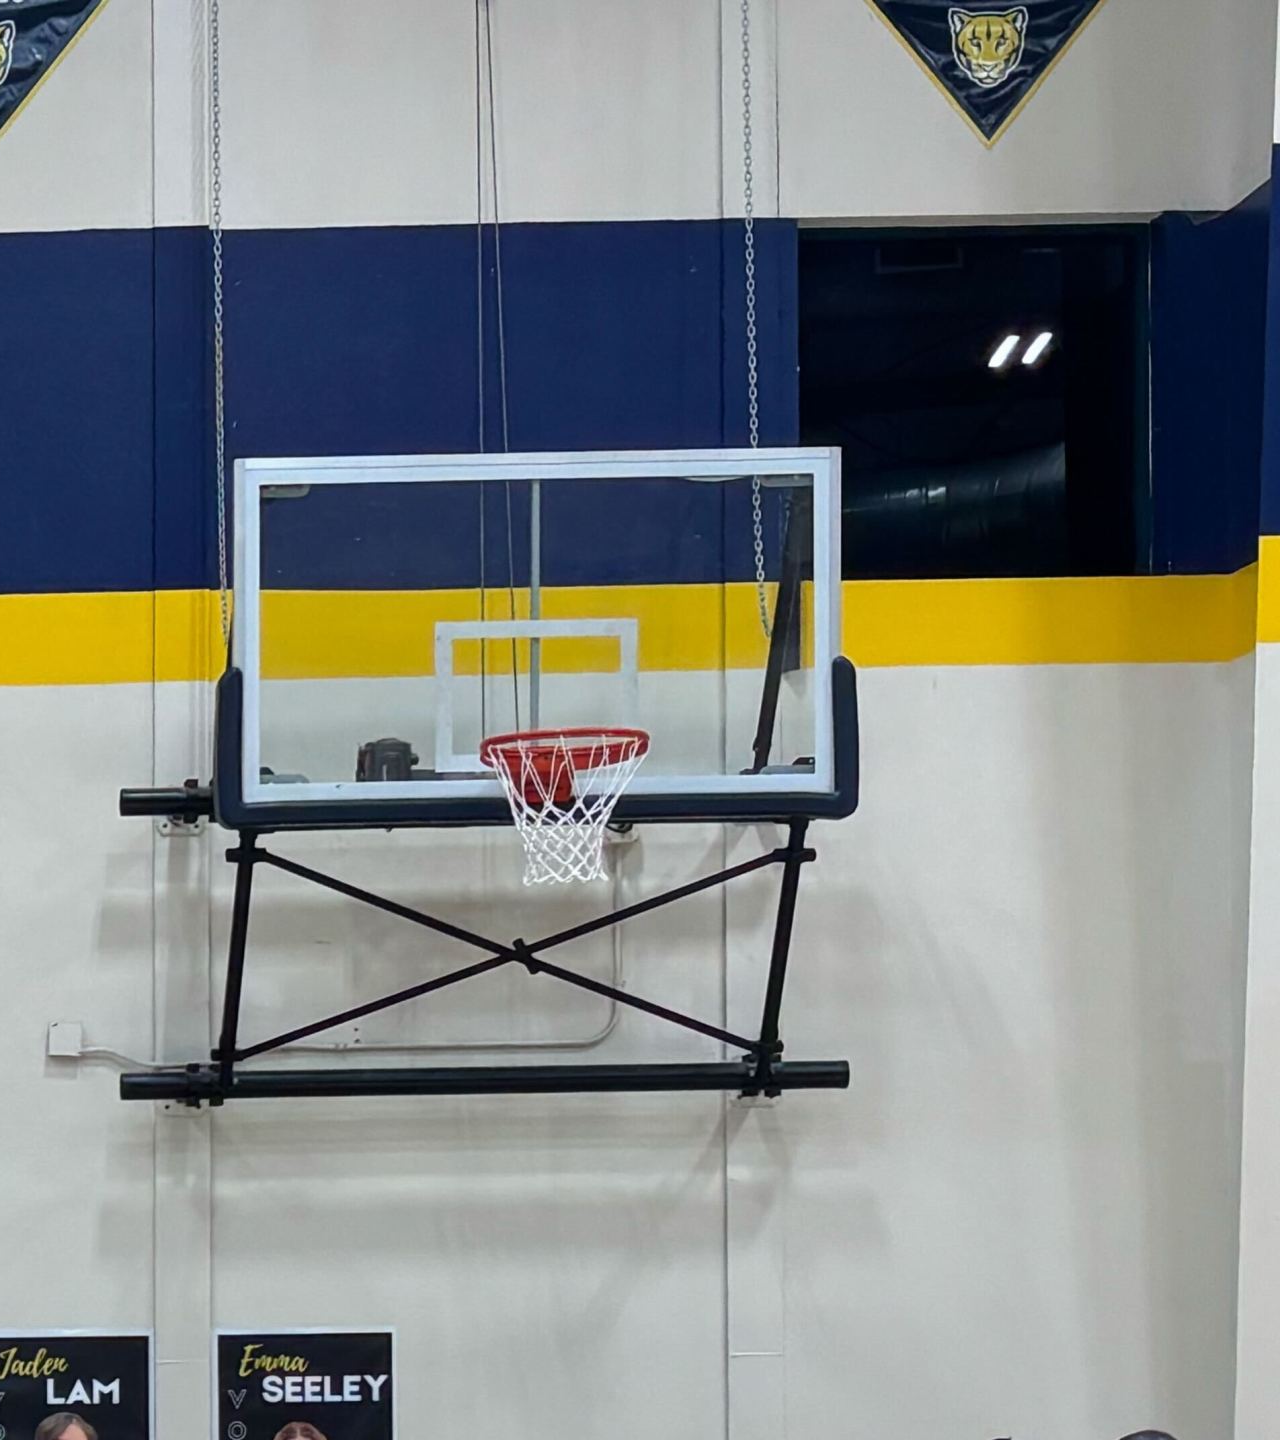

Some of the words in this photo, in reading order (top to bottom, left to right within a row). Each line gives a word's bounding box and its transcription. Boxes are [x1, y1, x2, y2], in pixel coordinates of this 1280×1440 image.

[240, 1344, 305, 1376] Emma
[47, 1379, 119, 1404] LAM
[263, 1374, 387, 1402] SEELEY
